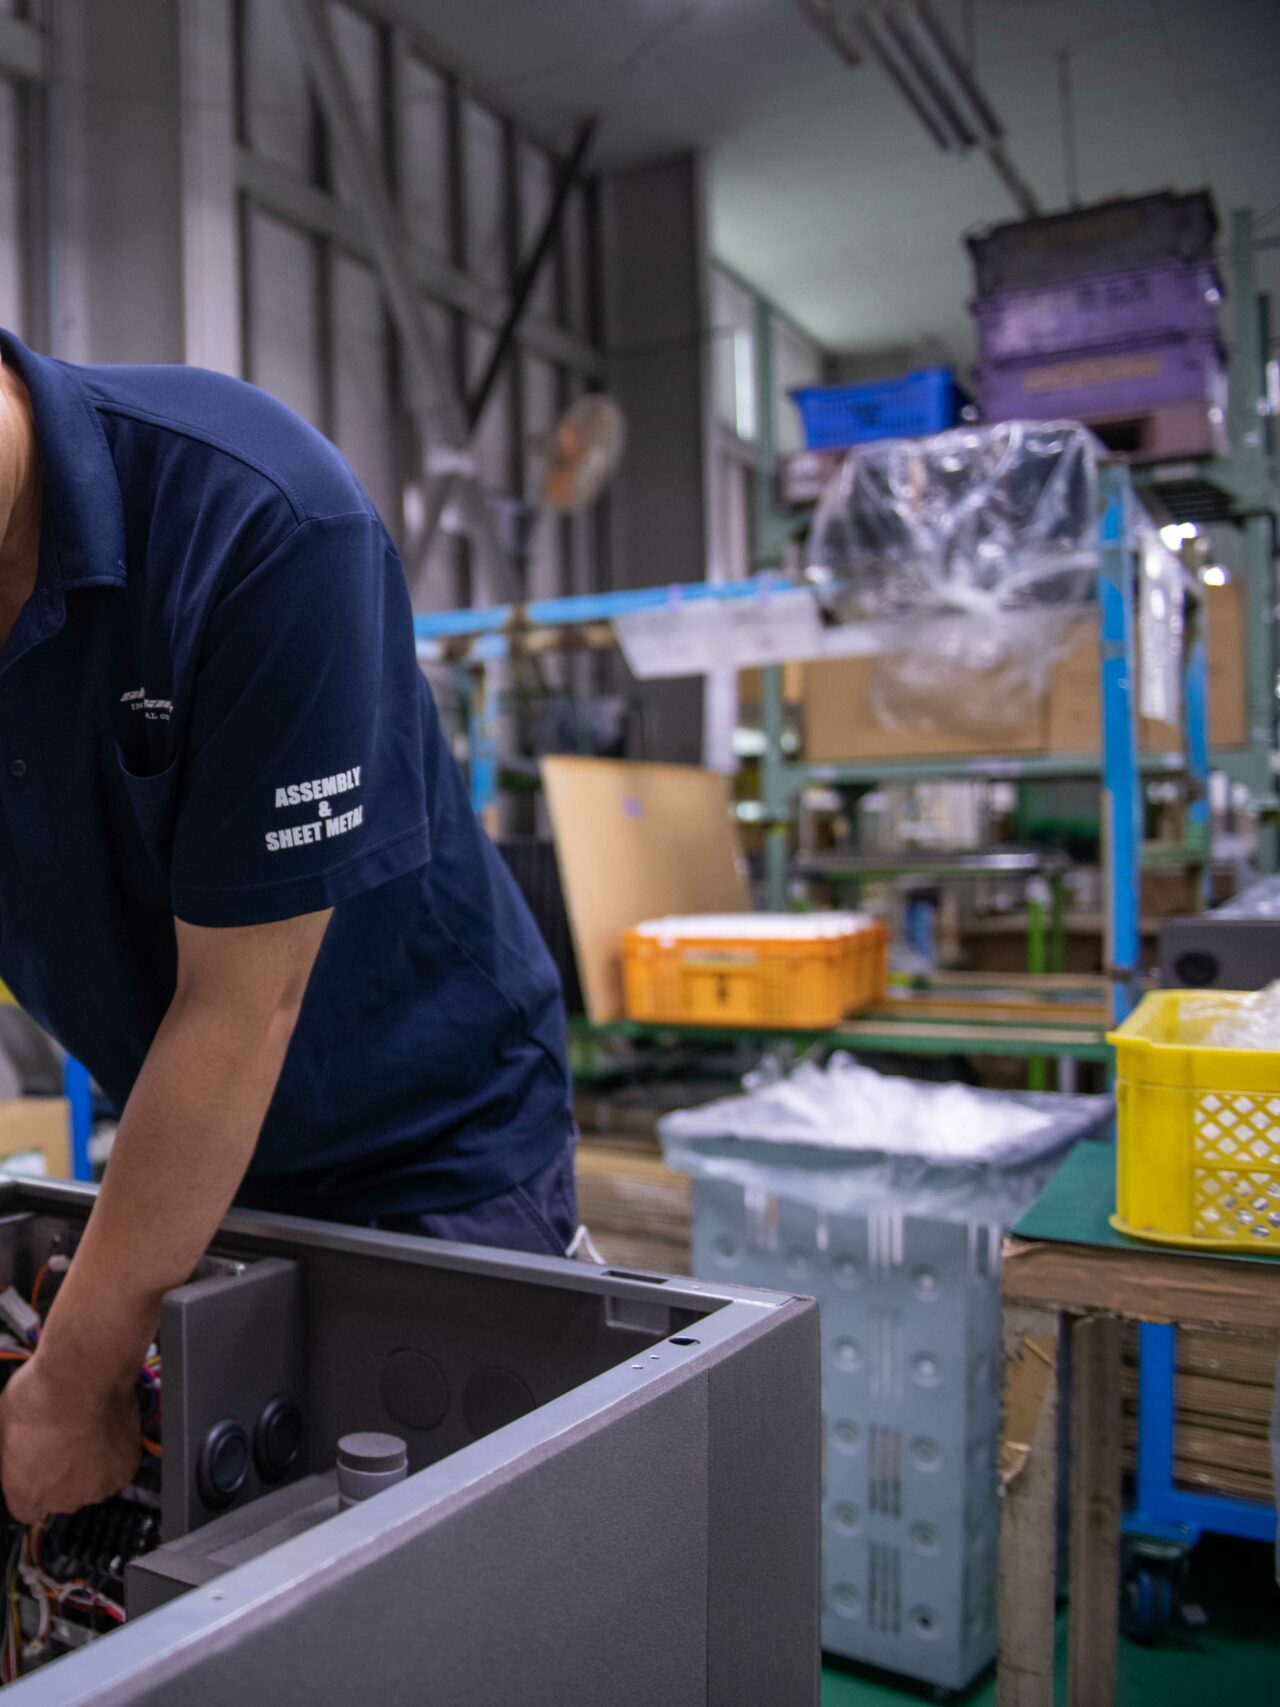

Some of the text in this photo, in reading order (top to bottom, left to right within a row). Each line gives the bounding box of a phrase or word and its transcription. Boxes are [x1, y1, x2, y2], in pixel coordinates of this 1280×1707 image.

[275, 766, 361, 808] ASSEMBLY
[318, 800, 331, 817] &
[265, 821, 322, 851] SHEET
